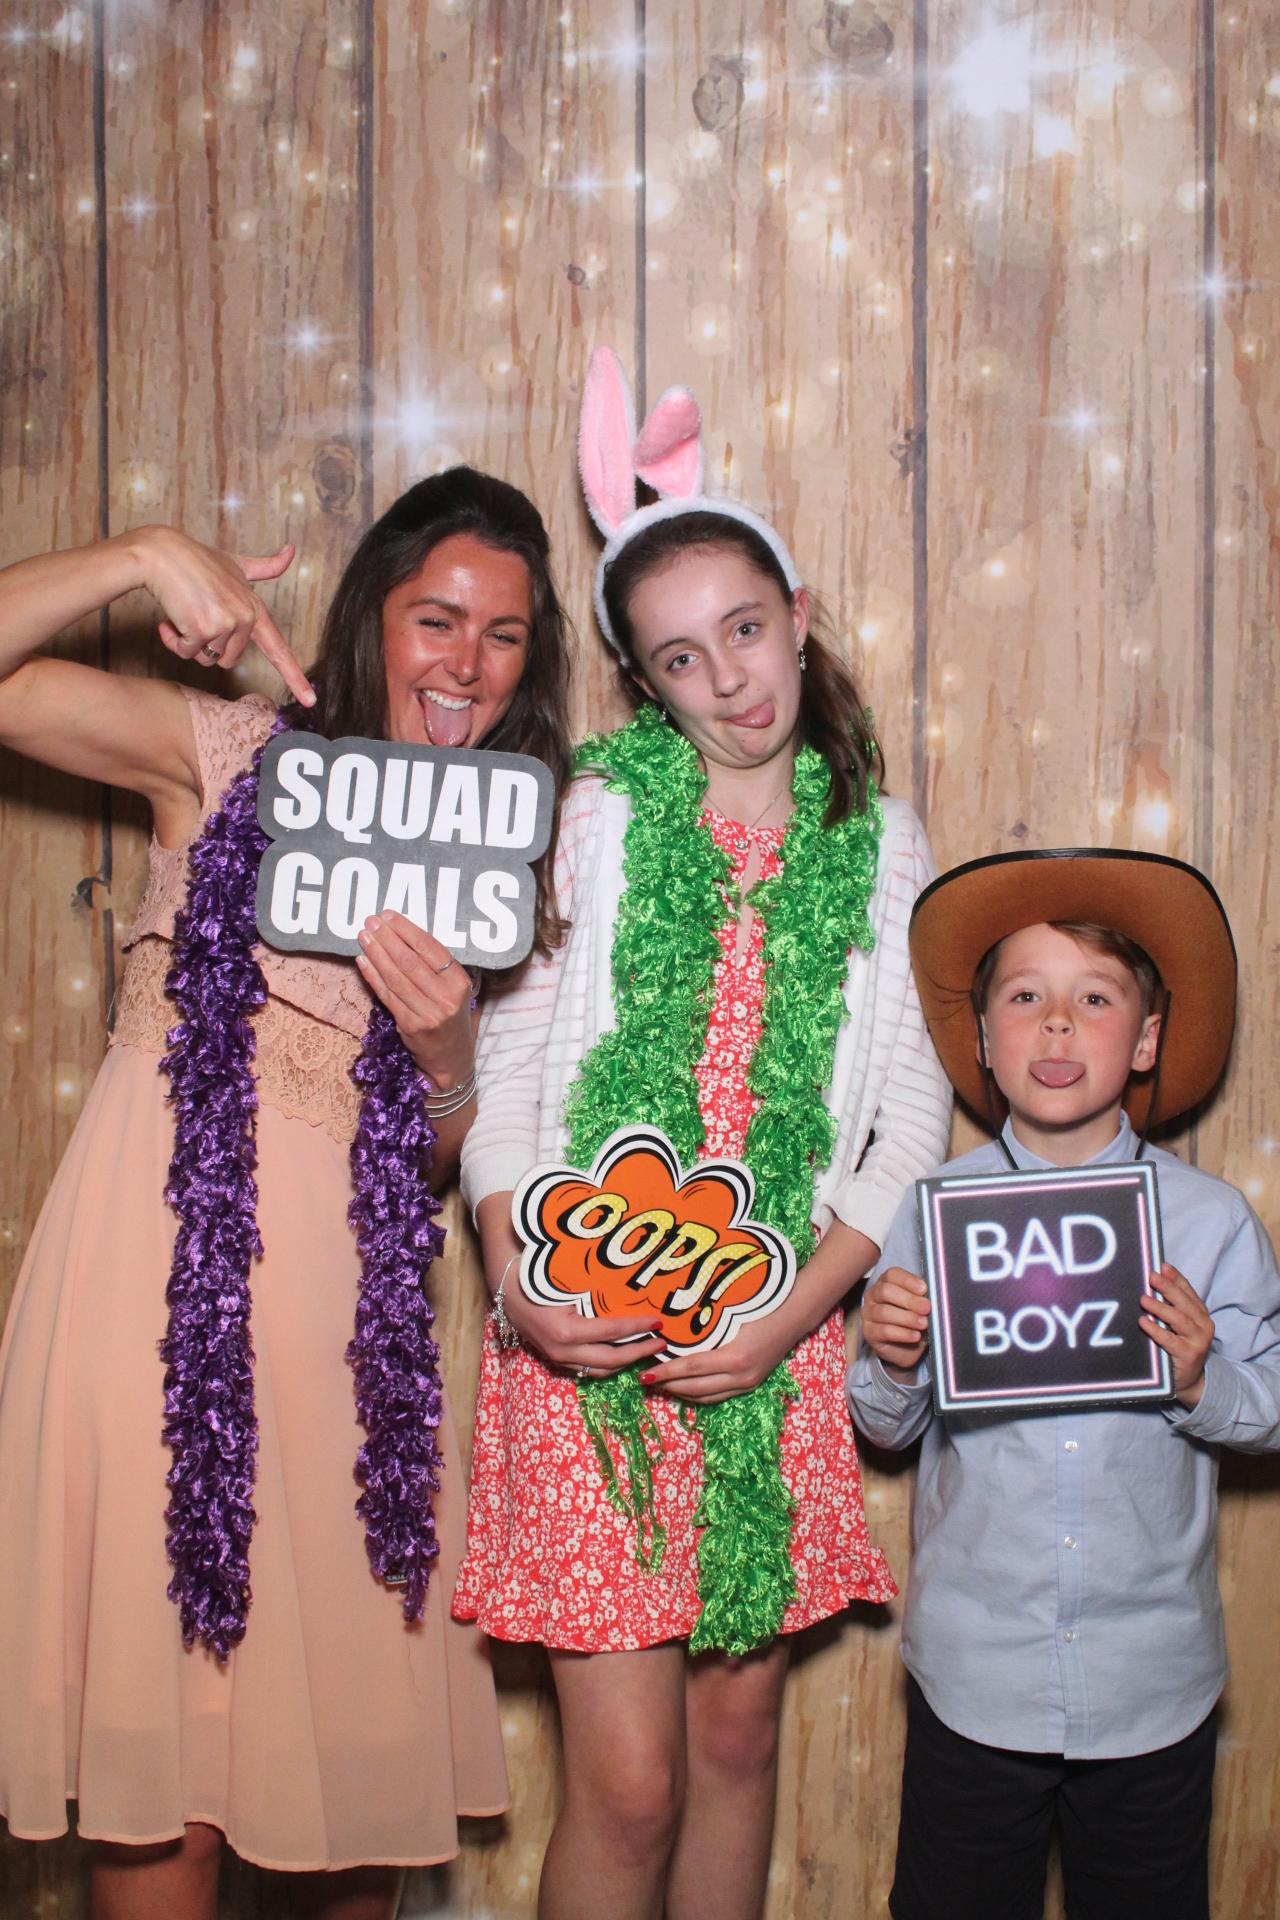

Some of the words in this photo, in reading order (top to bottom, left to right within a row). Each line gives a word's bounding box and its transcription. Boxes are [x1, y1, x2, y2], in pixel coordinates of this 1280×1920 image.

[273, 748, 539, 849] SQUAD
[270, 851, 520, 954] GOALS
[557, 1192, 777, 1335] OOPS!
[965, 1214, 1118, 1282] BAD
[974, 1301, 1124, 1355] BOYZ
